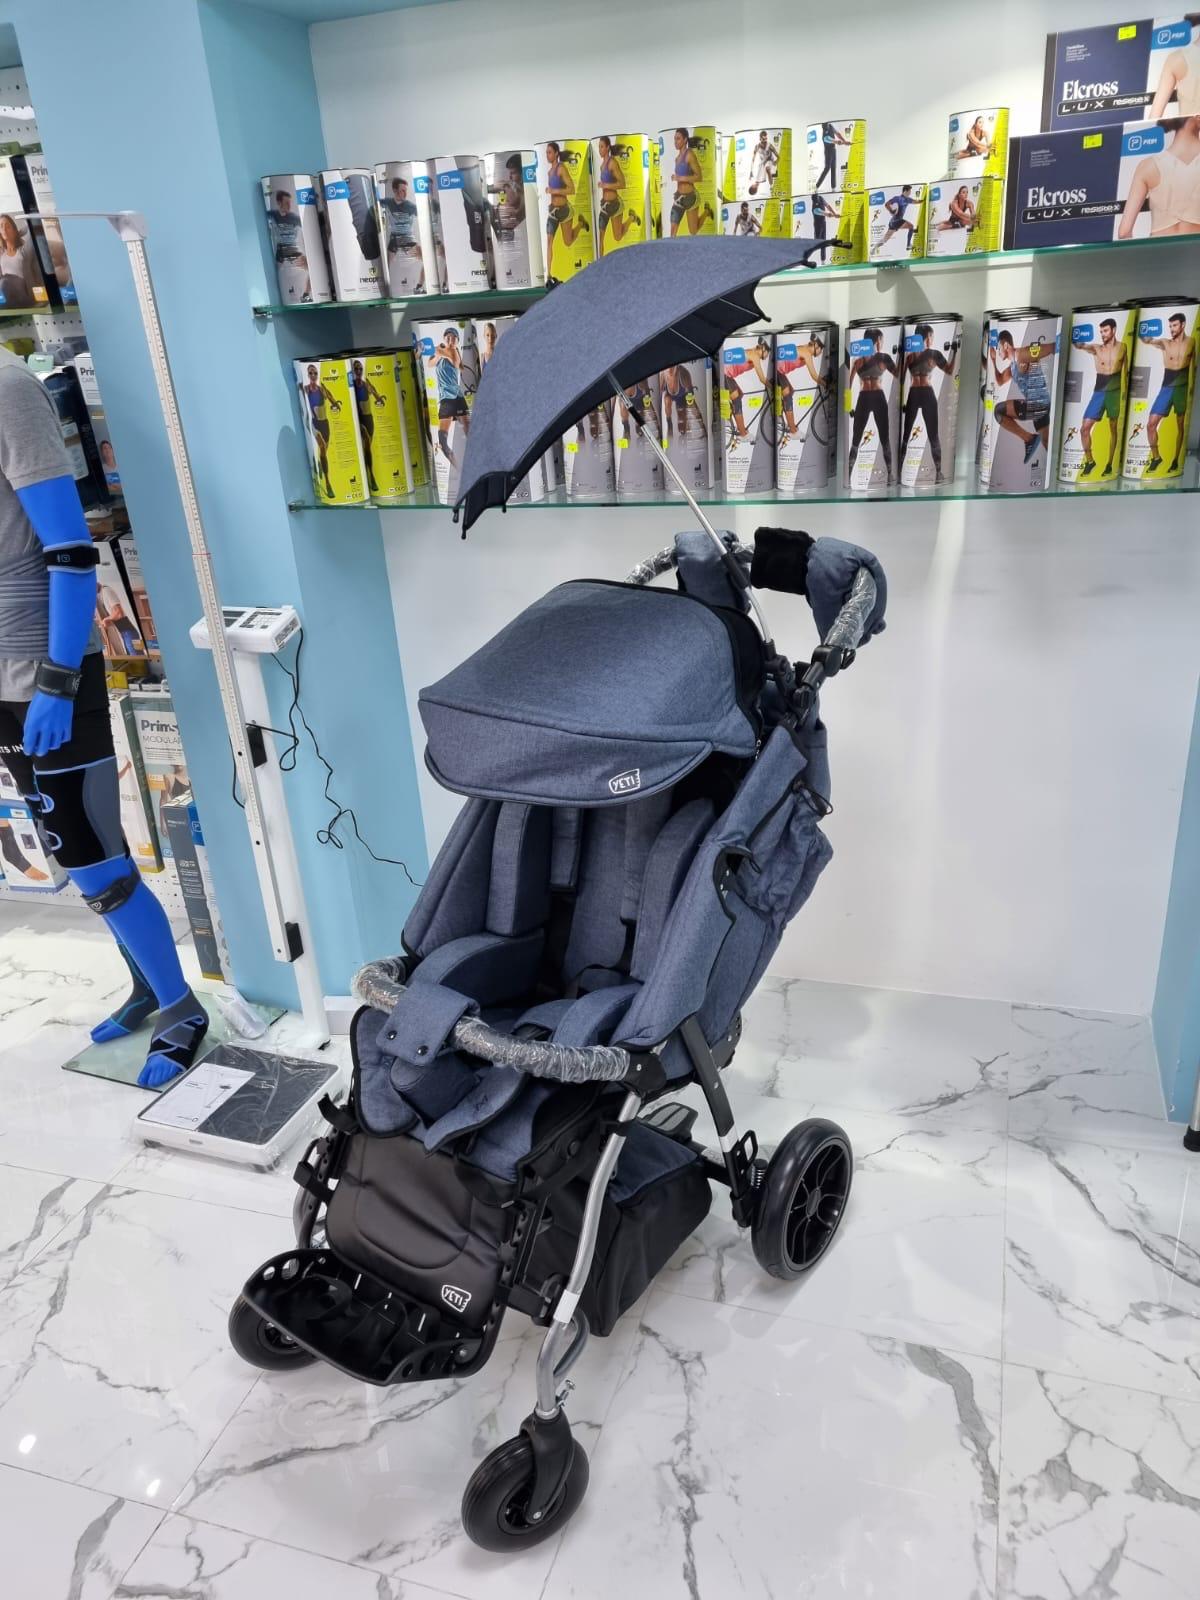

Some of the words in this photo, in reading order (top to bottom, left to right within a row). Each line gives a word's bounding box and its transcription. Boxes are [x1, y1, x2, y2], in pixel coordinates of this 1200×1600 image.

[1062, 80, 1119, 101] Elcross
[1027, 186, 1087, 208] Elcross
[612, 775, 636, 791] YETI
[444, 1288, 464, 1306] YETI
